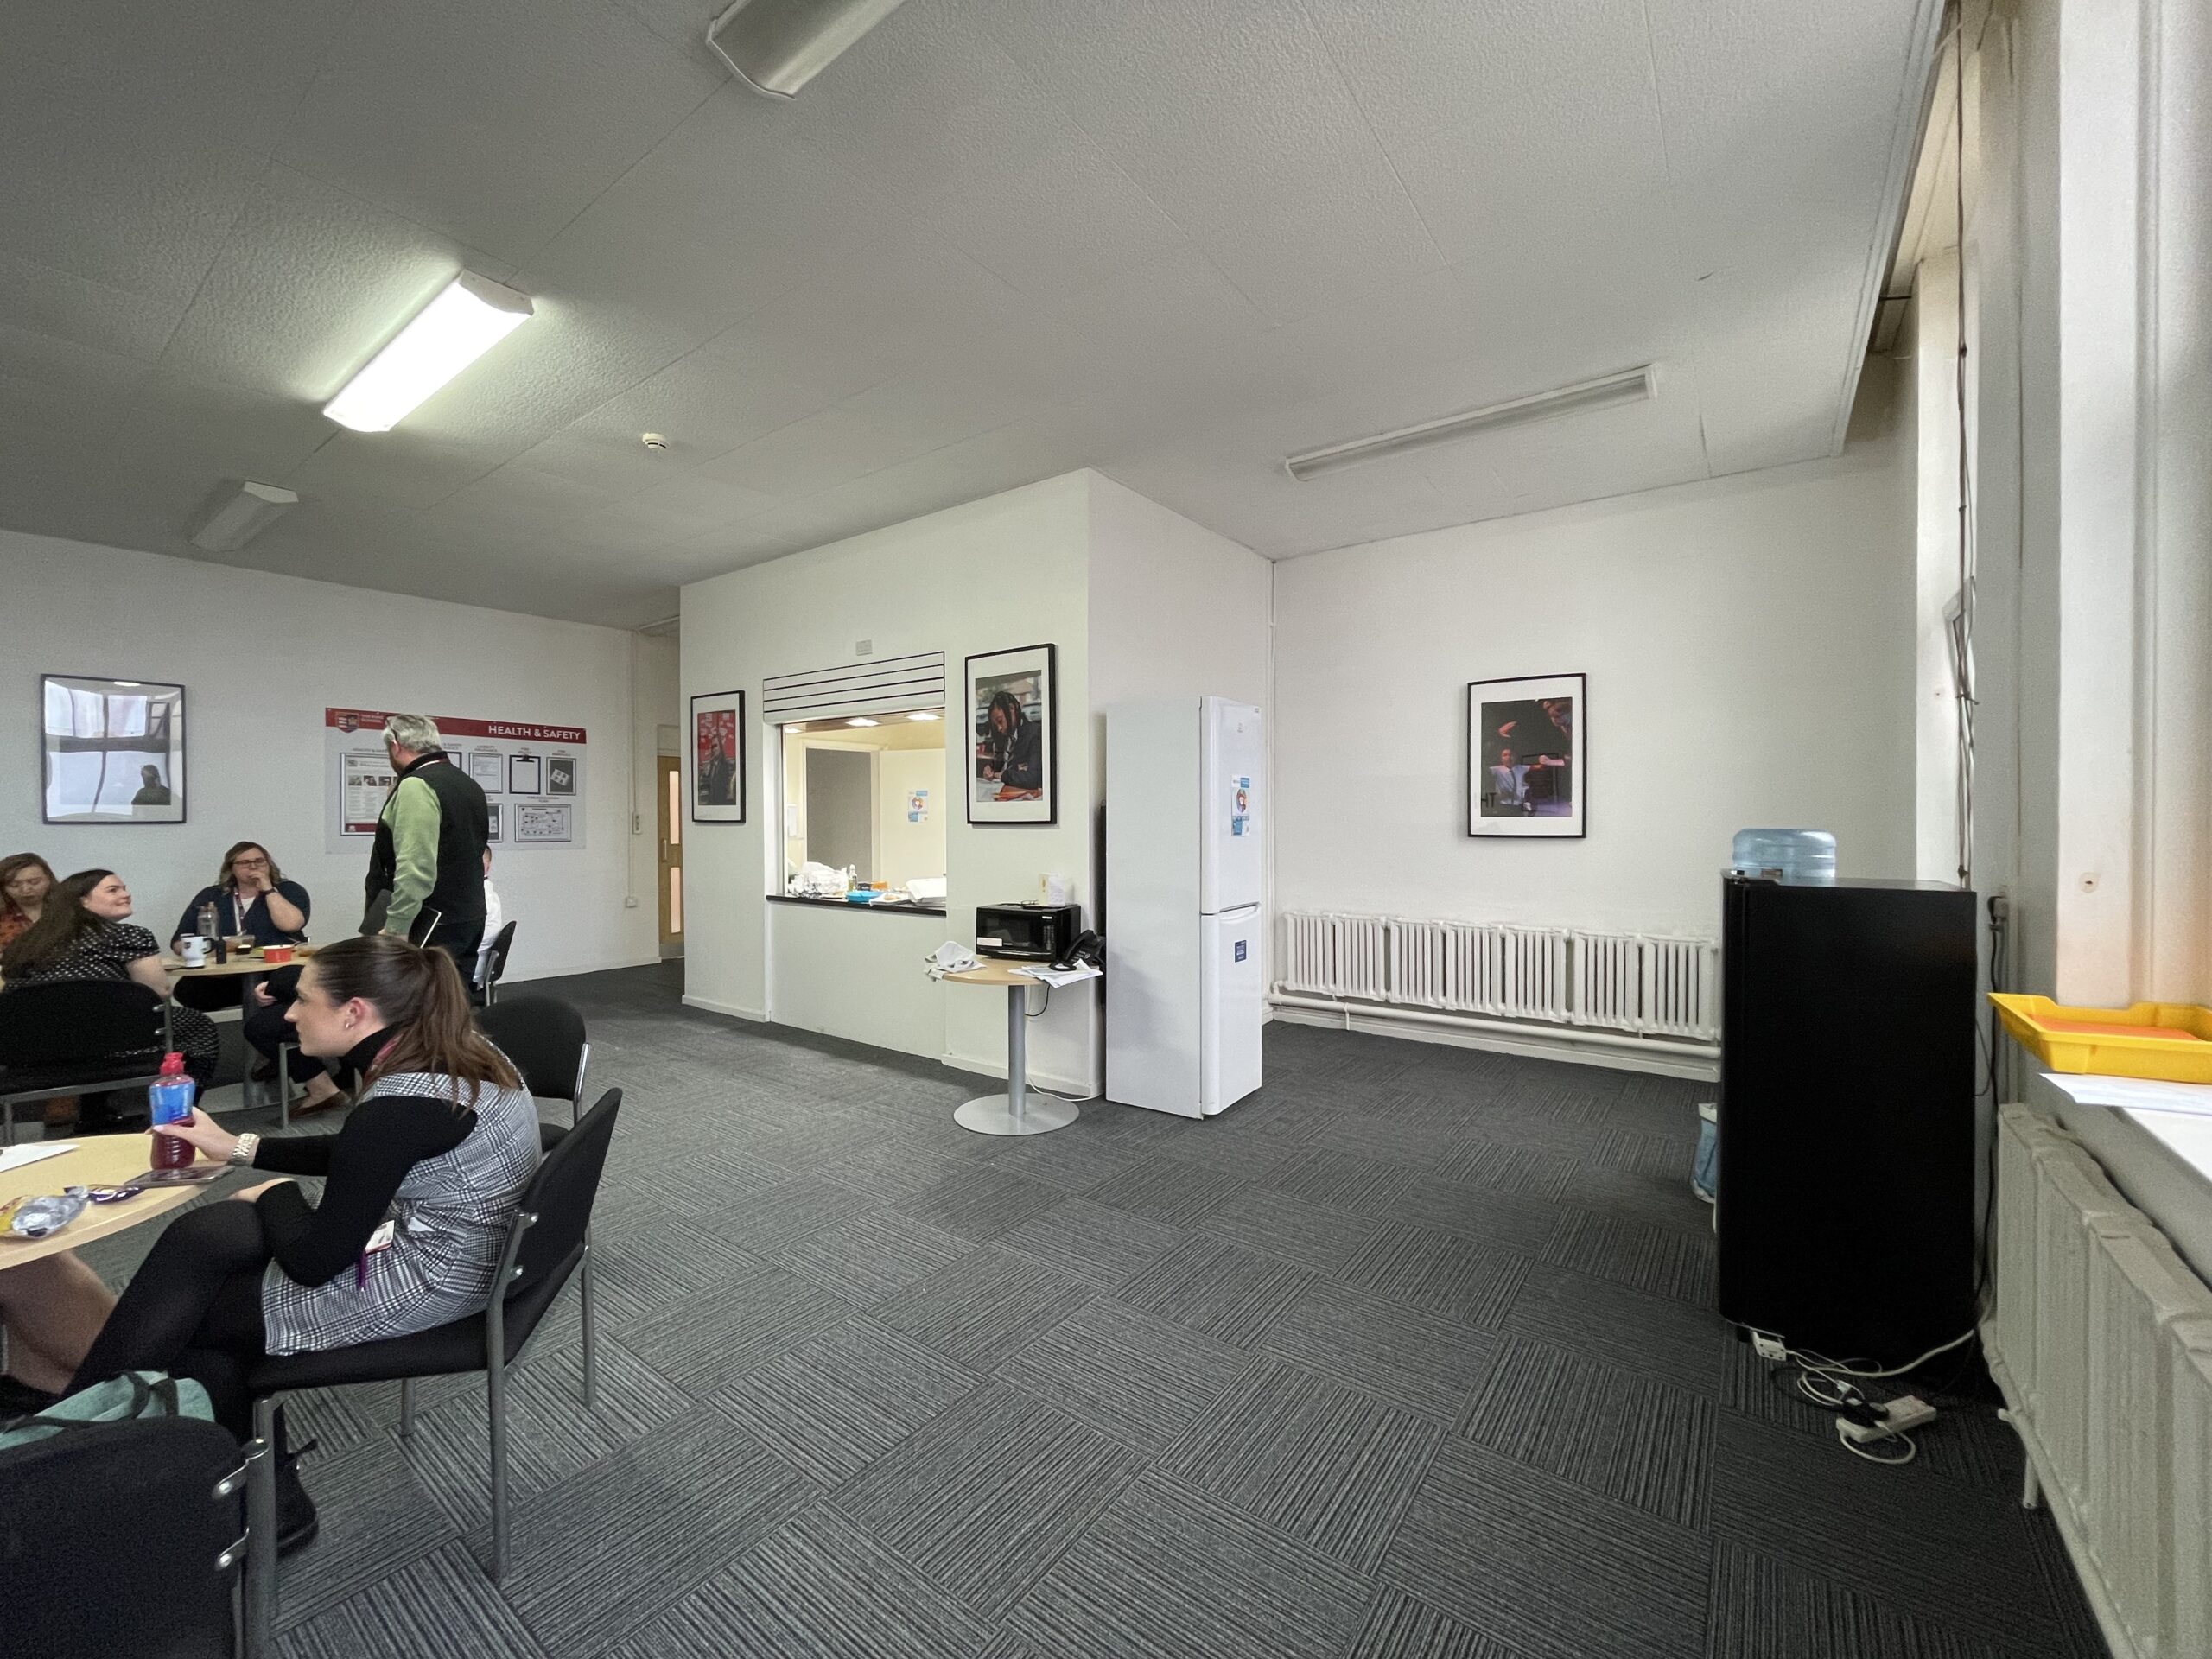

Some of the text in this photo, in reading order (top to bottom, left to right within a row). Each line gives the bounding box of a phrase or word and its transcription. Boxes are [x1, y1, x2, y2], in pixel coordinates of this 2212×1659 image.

[488, 725, 581, 741] HEALTH & SAFETY
